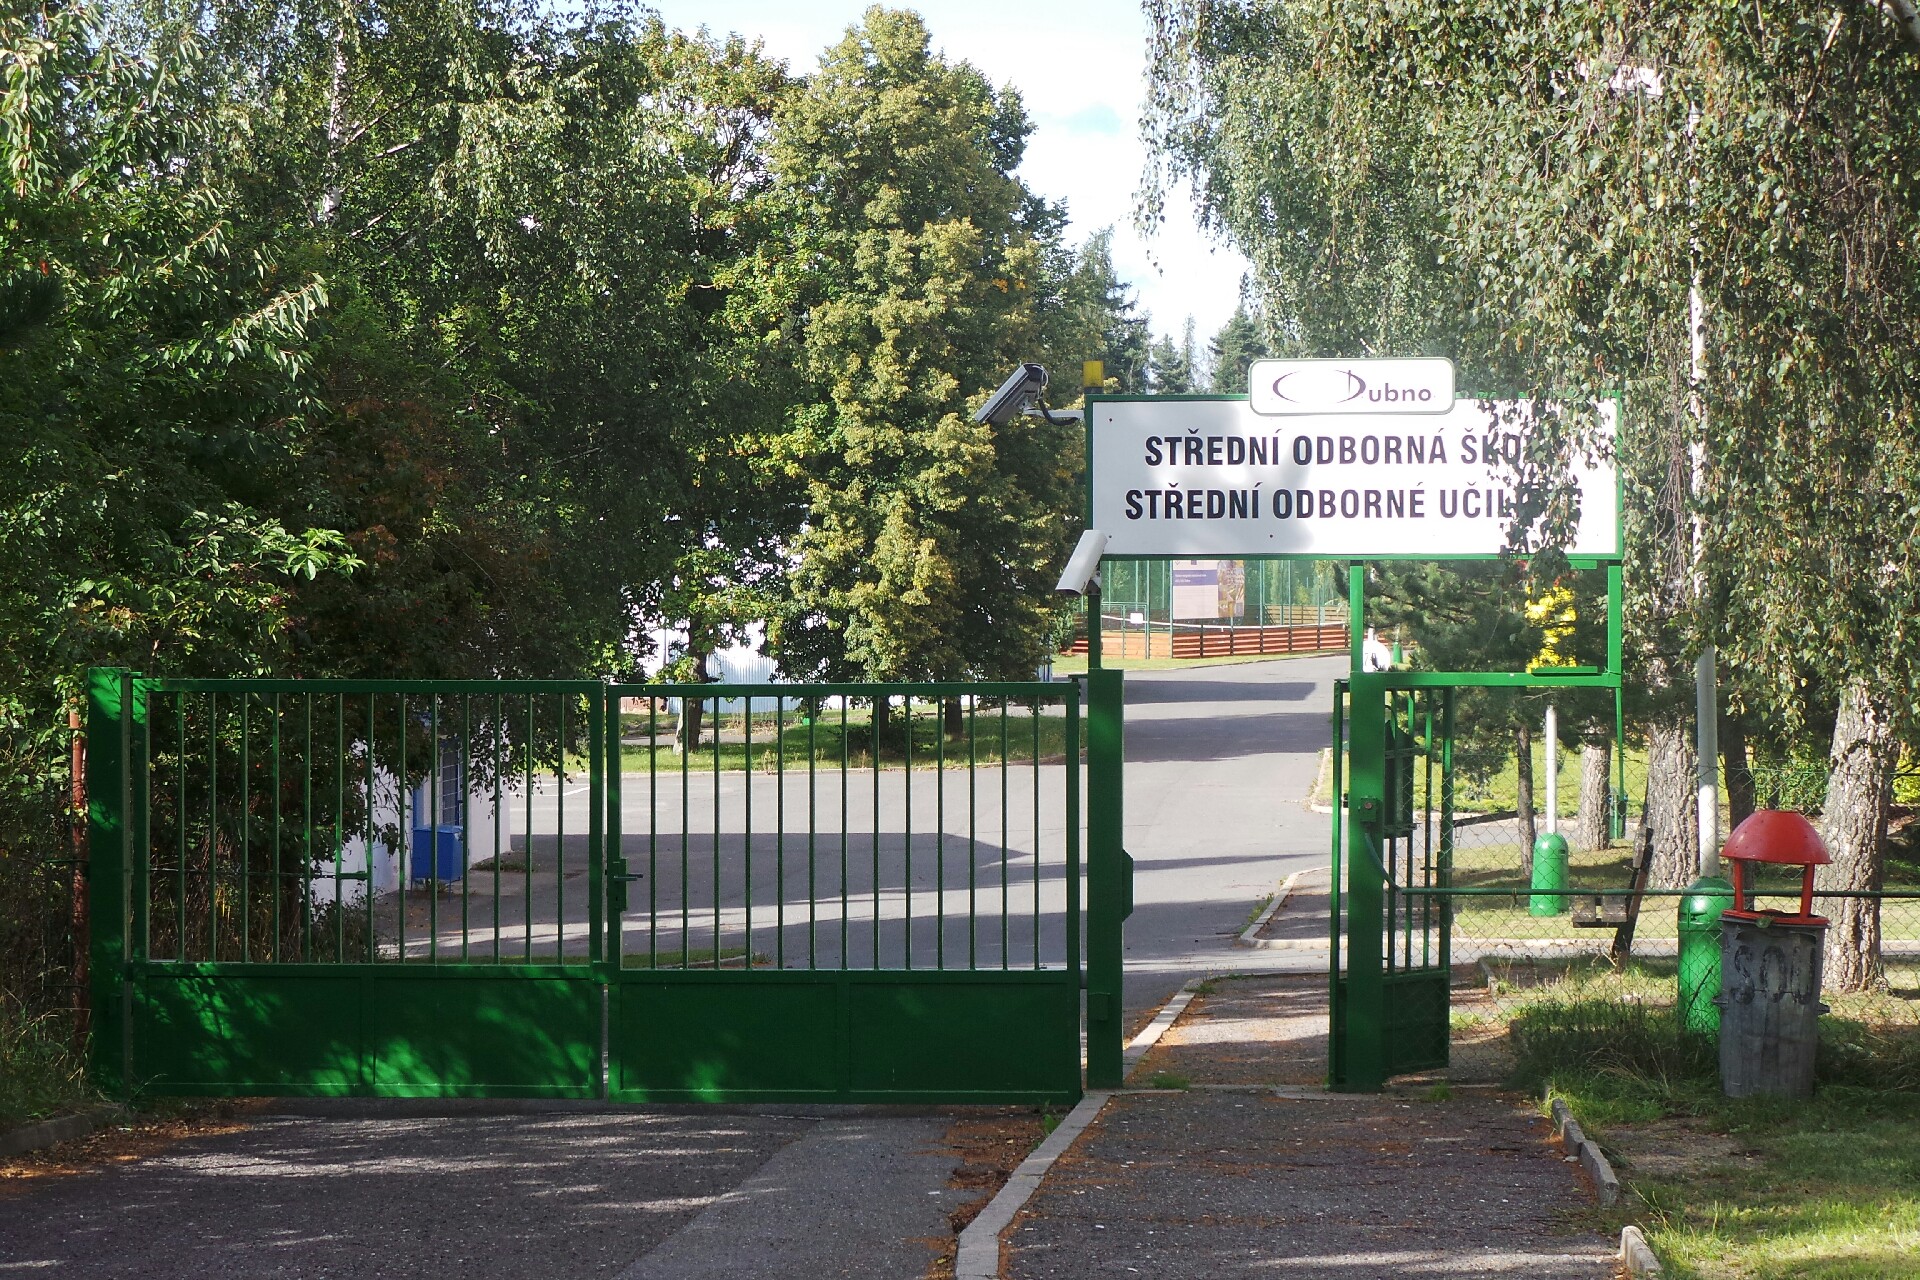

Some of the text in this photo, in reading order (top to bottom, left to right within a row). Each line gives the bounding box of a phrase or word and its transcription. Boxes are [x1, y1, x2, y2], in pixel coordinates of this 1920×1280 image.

[1335, 369, 1432, 403] Dubno
[1144, 428, 1281, 467] STŘEDNÍ
[1292, 428, 1447, 466] ODBORNÁ
[1124, 482, 1263, 520] STŘEDNÍ
[1272, 482, 1426, 519] ODBORNÉ
